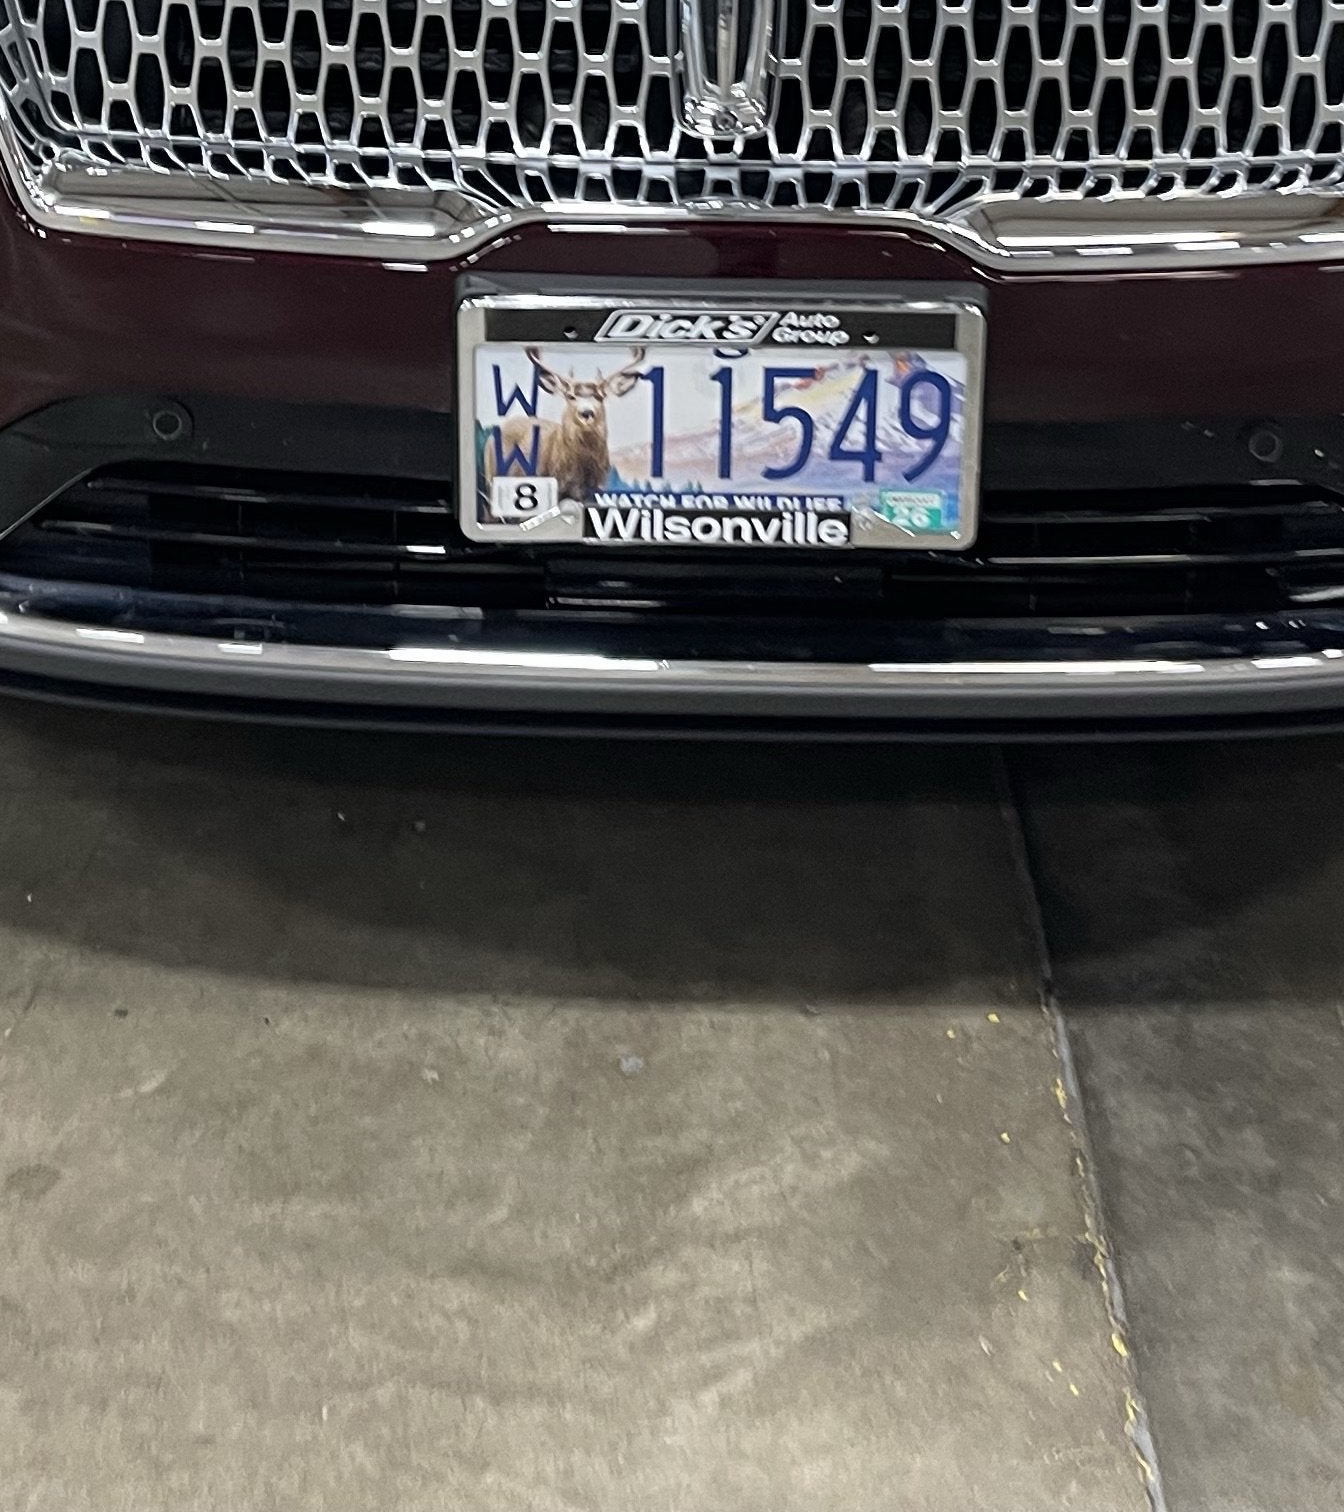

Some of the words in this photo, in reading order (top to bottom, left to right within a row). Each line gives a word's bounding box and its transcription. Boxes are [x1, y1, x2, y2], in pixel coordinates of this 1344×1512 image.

[607, 313, 765, 340] Dick's
[778, 311, 840, 329] Auto
[771, 327, 850, 346] Group
[640, 365, 951, 482] 11549
[514, 483, 539, 510] 8
[587, 507, 849, 546] Wilsonville
